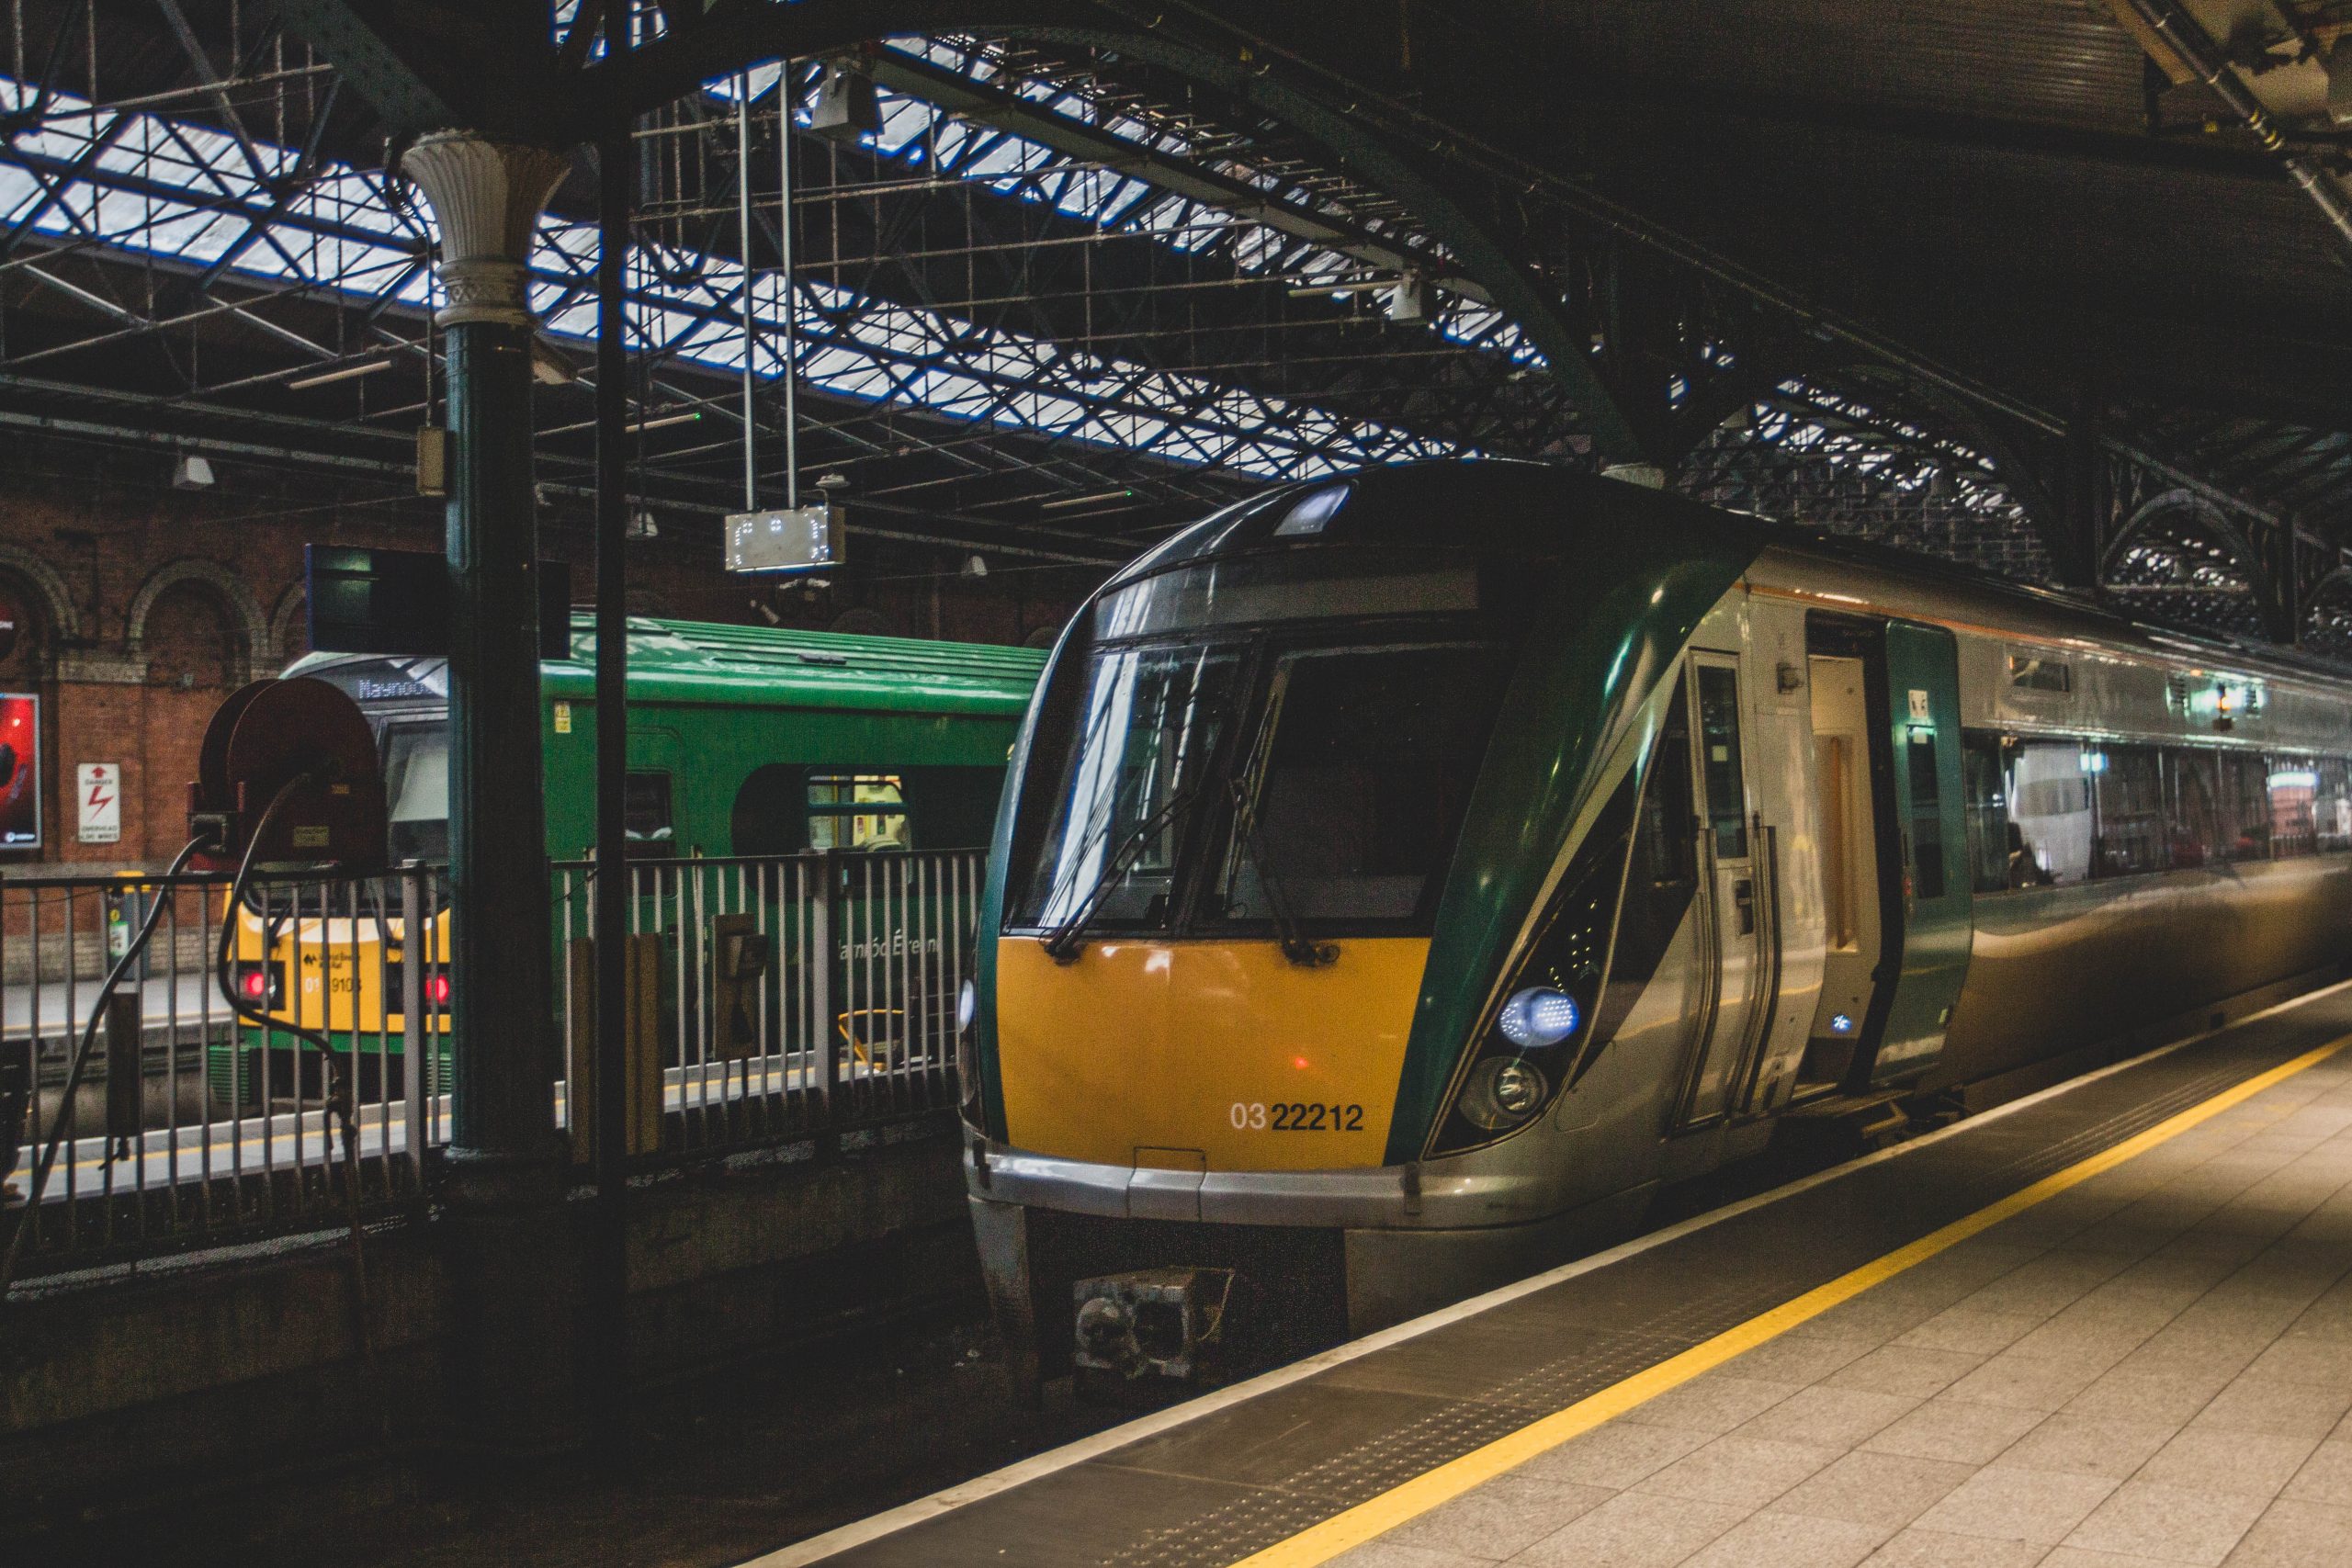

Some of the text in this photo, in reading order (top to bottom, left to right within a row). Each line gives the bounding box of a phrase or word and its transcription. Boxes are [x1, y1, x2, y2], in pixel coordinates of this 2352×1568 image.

[359, 679, 441, 699] Maynoo
[304, 976, 320, 993] 01
[1230, 1102, 1364, 1132] 03 22212
